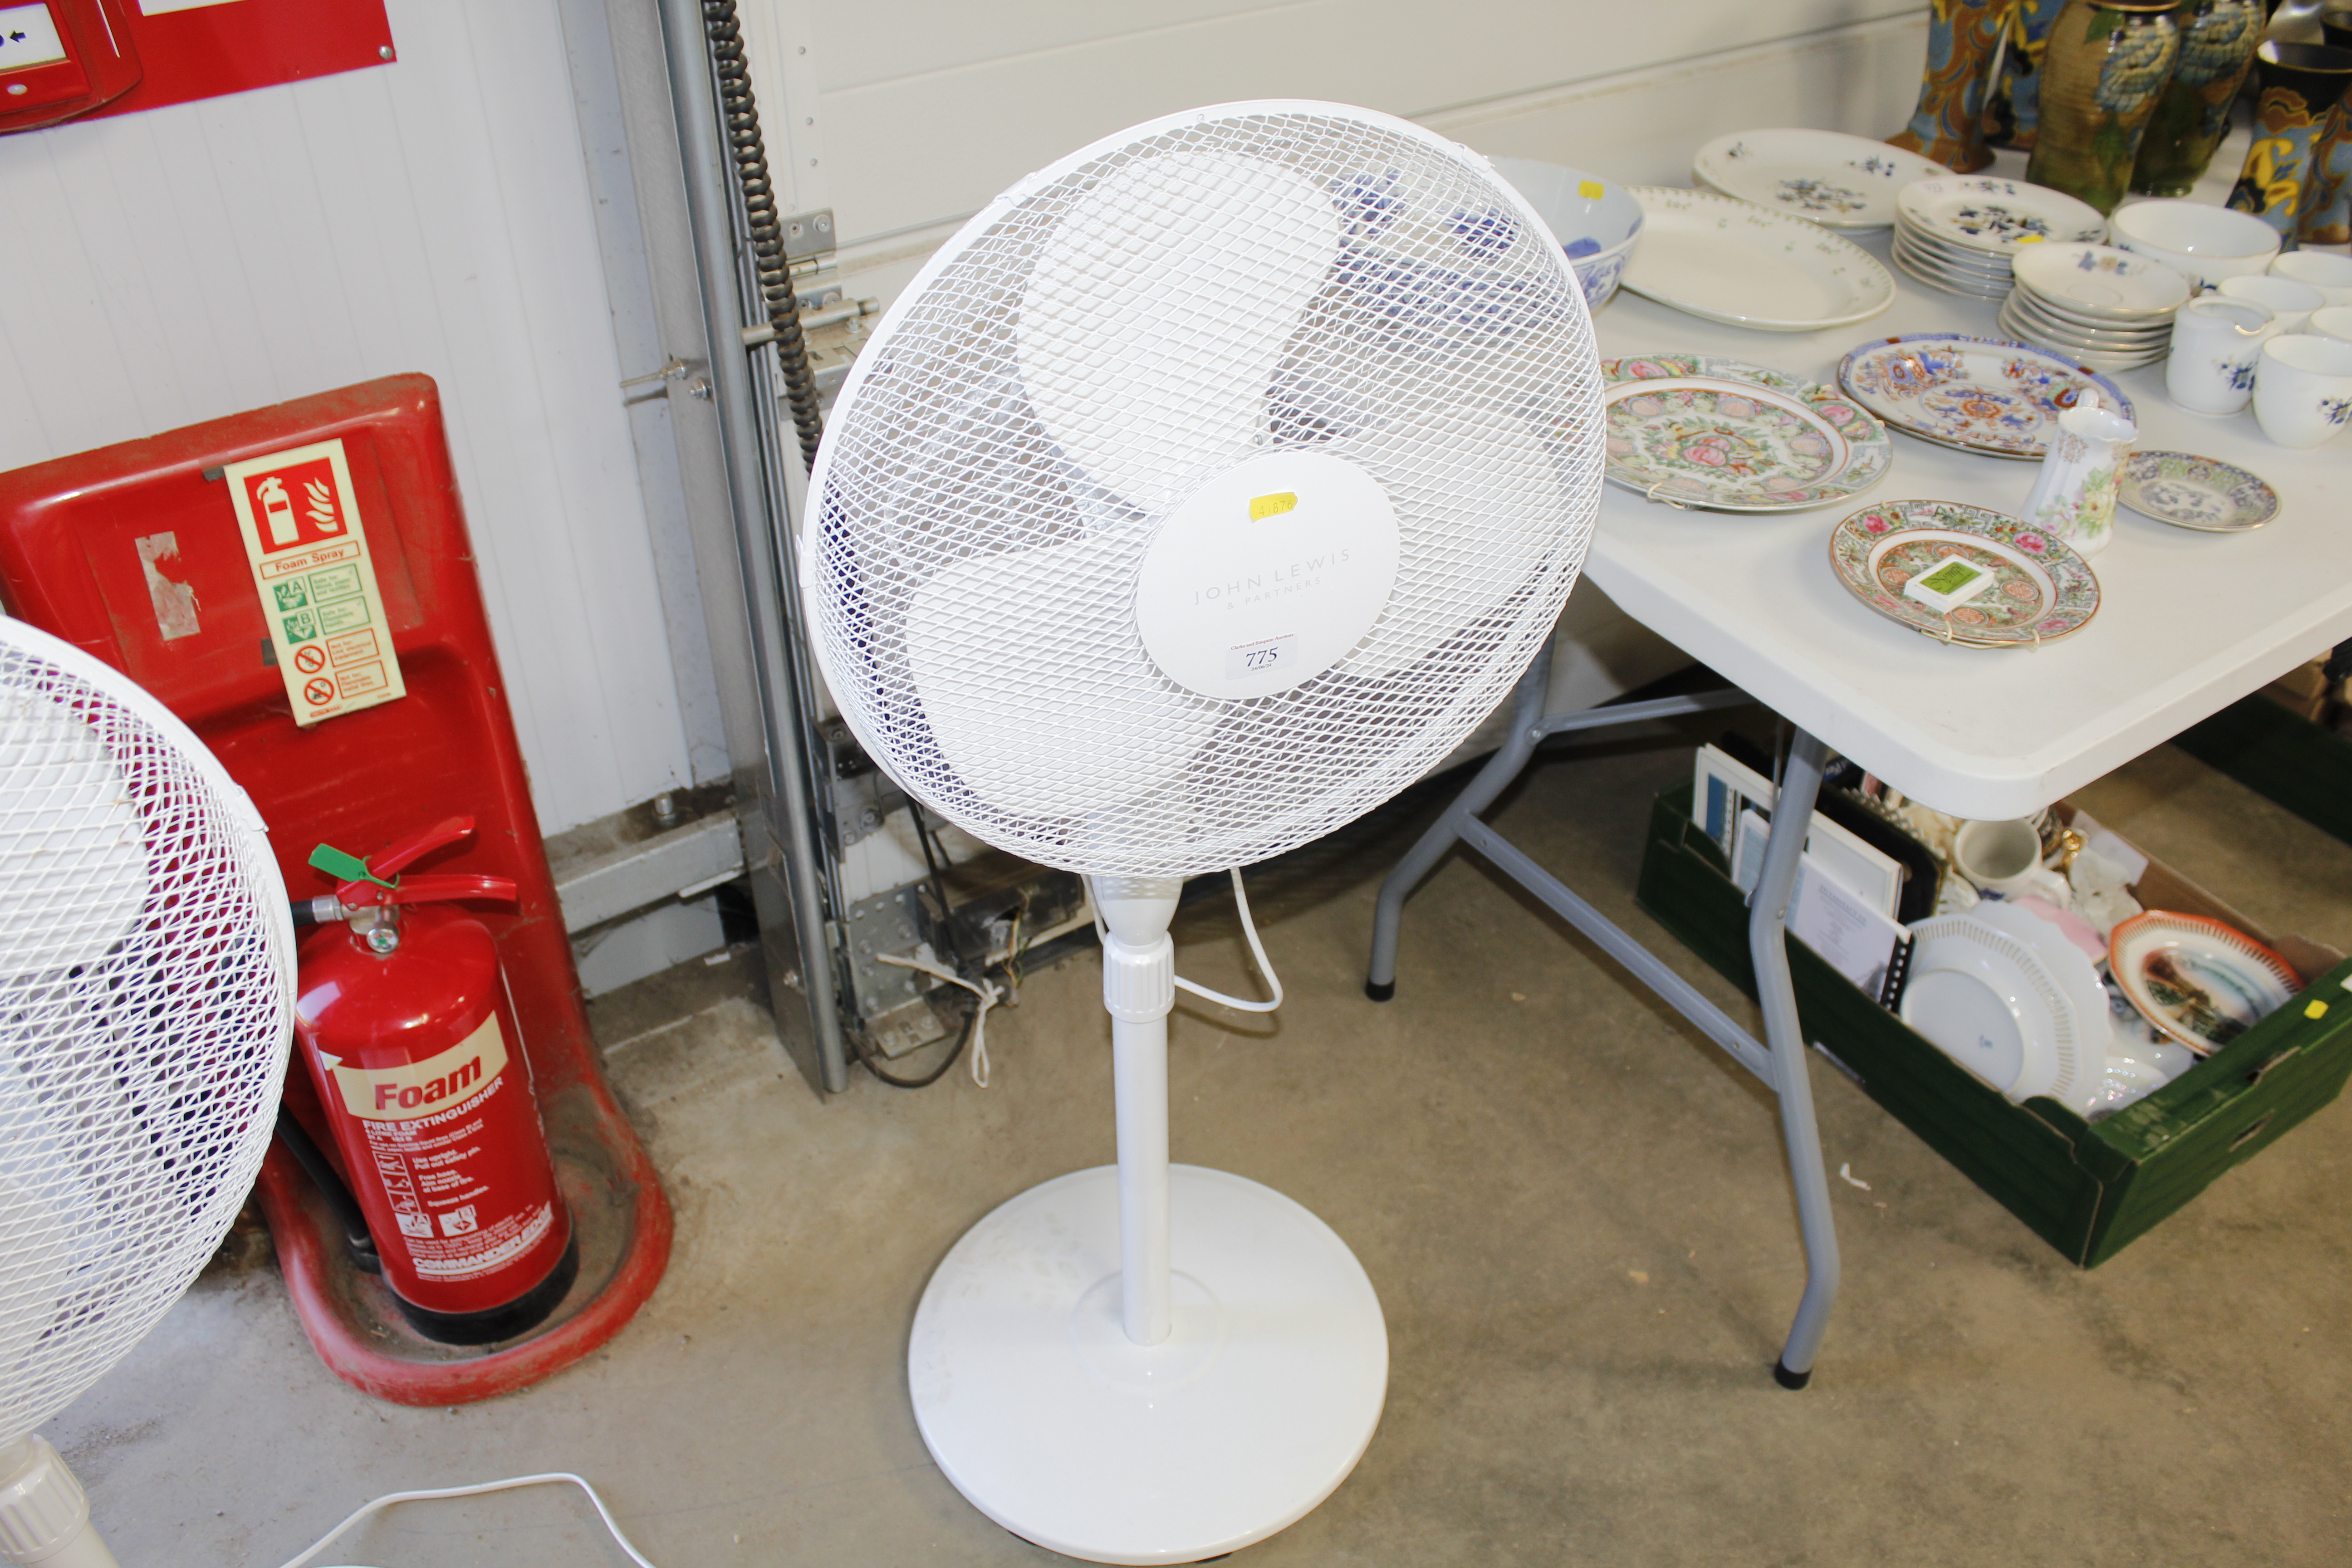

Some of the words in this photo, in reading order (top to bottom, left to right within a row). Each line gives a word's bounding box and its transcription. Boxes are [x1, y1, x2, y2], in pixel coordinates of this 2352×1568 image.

[1259, 500, 1293, 515] 41876
[275, 559, 307, 572] Foam
[312, 549, 344, 564] Spray
[1195, 574, 1261, 605] JOHN
[1275, 549, 1349, 582] LEWIS
[293, 581, 303, 592] A
[1245, 577, 1320, 604] PARTNERS
[300, 613, 310, 624] B
[1245, 646, 1279, 667] 775
[1251, 663, 1272, 671] 24/06/24
[375, 1055, 481, 1110] Foam
[362, 1119, 398, 1132] FIRE
[400, 1076, 504, 1131] EXTINGUISHER
[429, 1149, 458, 1161] upright.
[431, 1160, 445, 1168] out
[445, 1152, 467, 1165] safety
[467, 1146, 481, 1157] pin.
[431, 1184, 451, 1192] base
[451, 1180, 460, 1188] of
[437, 1174, 461, 1185] nozzle
[427, 1197, 460, 1207] Squeeze
[412, 1234, 521, 1269] COMMANDER
